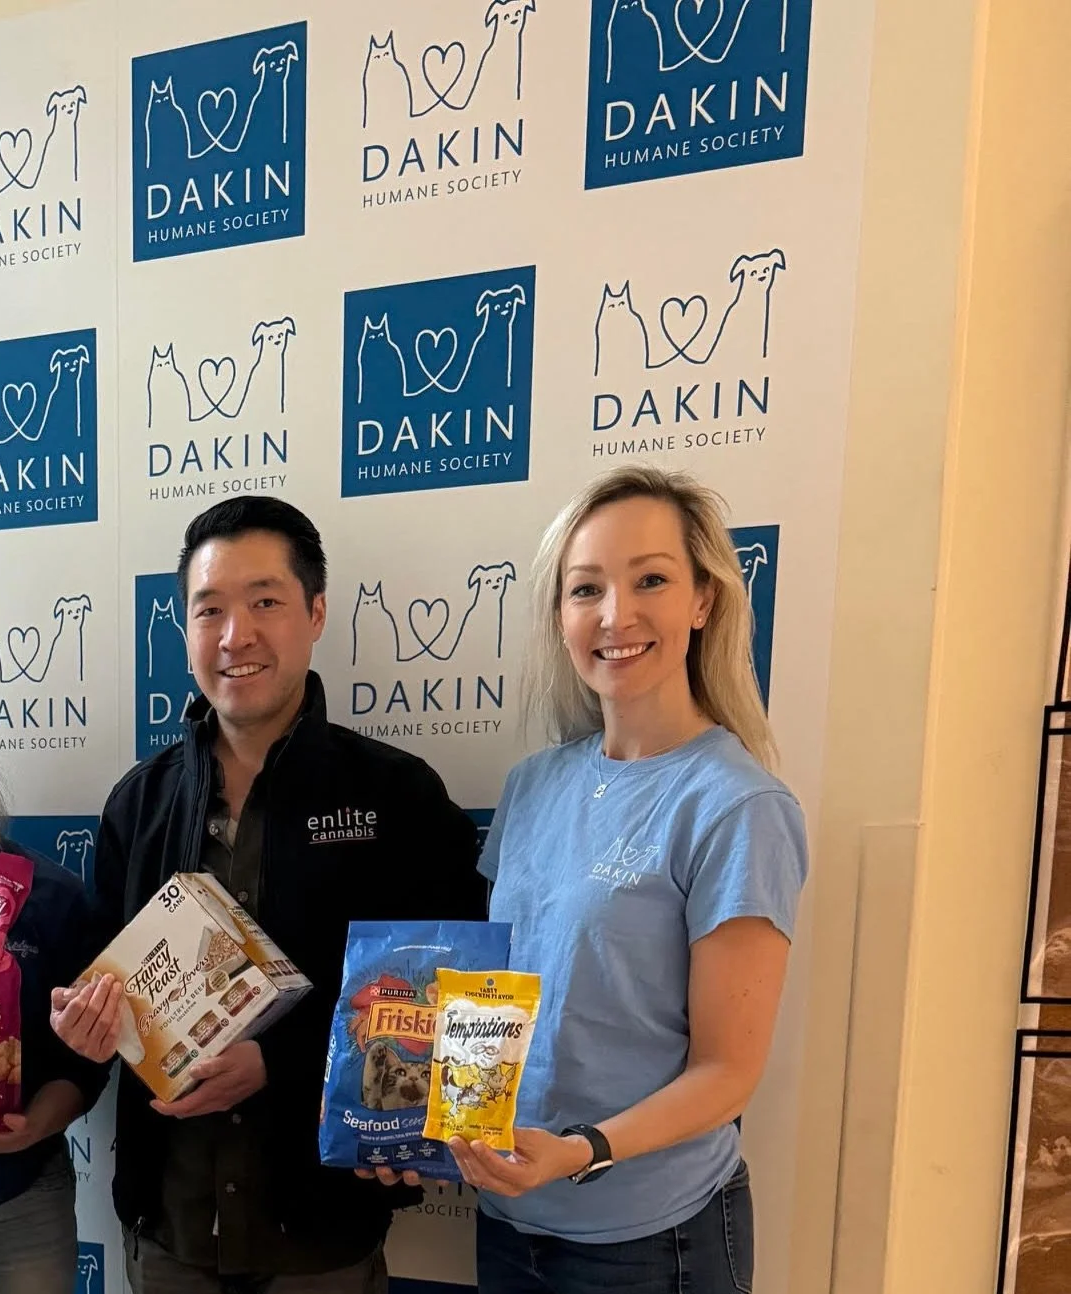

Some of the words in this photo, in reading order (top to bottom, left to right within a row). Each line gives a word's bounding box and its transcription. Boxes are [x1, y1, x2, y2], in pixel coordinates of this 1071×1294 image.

[605, 72, 787, 142] DAKIN
[363, 119, 524, 182] DAKIN
[604, 142, 692, 169] HUMANE
[699, 125, 785, 153] SOCIETY
[146, 161, 290, 220] DAKIN
[363, 184, 441, 208] HUMANE
[446, 170, 522, 195] SOCIETY
[147, 220, 217, 244] HUMANE
[223, 209, 290, 232] SOCIETY
[22, 243, 82, 266] SOCIETY
[593, 377, 769, 431] DAKIN
[358, 405, 514, 455] DAKIN
[593, 435, 676, 457] HUMANE
[682, 427, 767, 450] SOCIETY
[148, 430, 287, 478] DAKIN
[358, 460, 433, 480] HUMANE
[439, 453, 512, 473] SOCIETY
[149, 480, 218, 500] HUMANE
[223, 475, 287, 496] SOCIETY
[26, 496, 84, 513] SOCIETY
[352, 675, 503, 715] DAKIN
[30, 736, 87, 750] SOCIETY
[353, 723, 424, 738] HUMANE
[431, 720, 502, 735] SOCIETY
[307, 807, 378, 830] enlite
[312, 826, 375, 842] cannabis
[591, 863, 642, 886] DAKIN
[158, 885, 180, 909] 30
[168, 894, 186, 914] CANS
[125, 945, 171, 995] Fancy
[142, 956, 182, 1003] Feast
[137, 996, 171, 1037] Gravy
[177, 955, 210, 998] Lovers
[159, 1005, 188, 1031] POULTRY
[191, 983, 207, 1001] BEEF
[381, 988, 415, 998] PURINA
[375, 1008, 437, 1034] Friski
[444, 1010, 523, 1046] Temptations
[343, 1110, 399, 1132] Seafood
